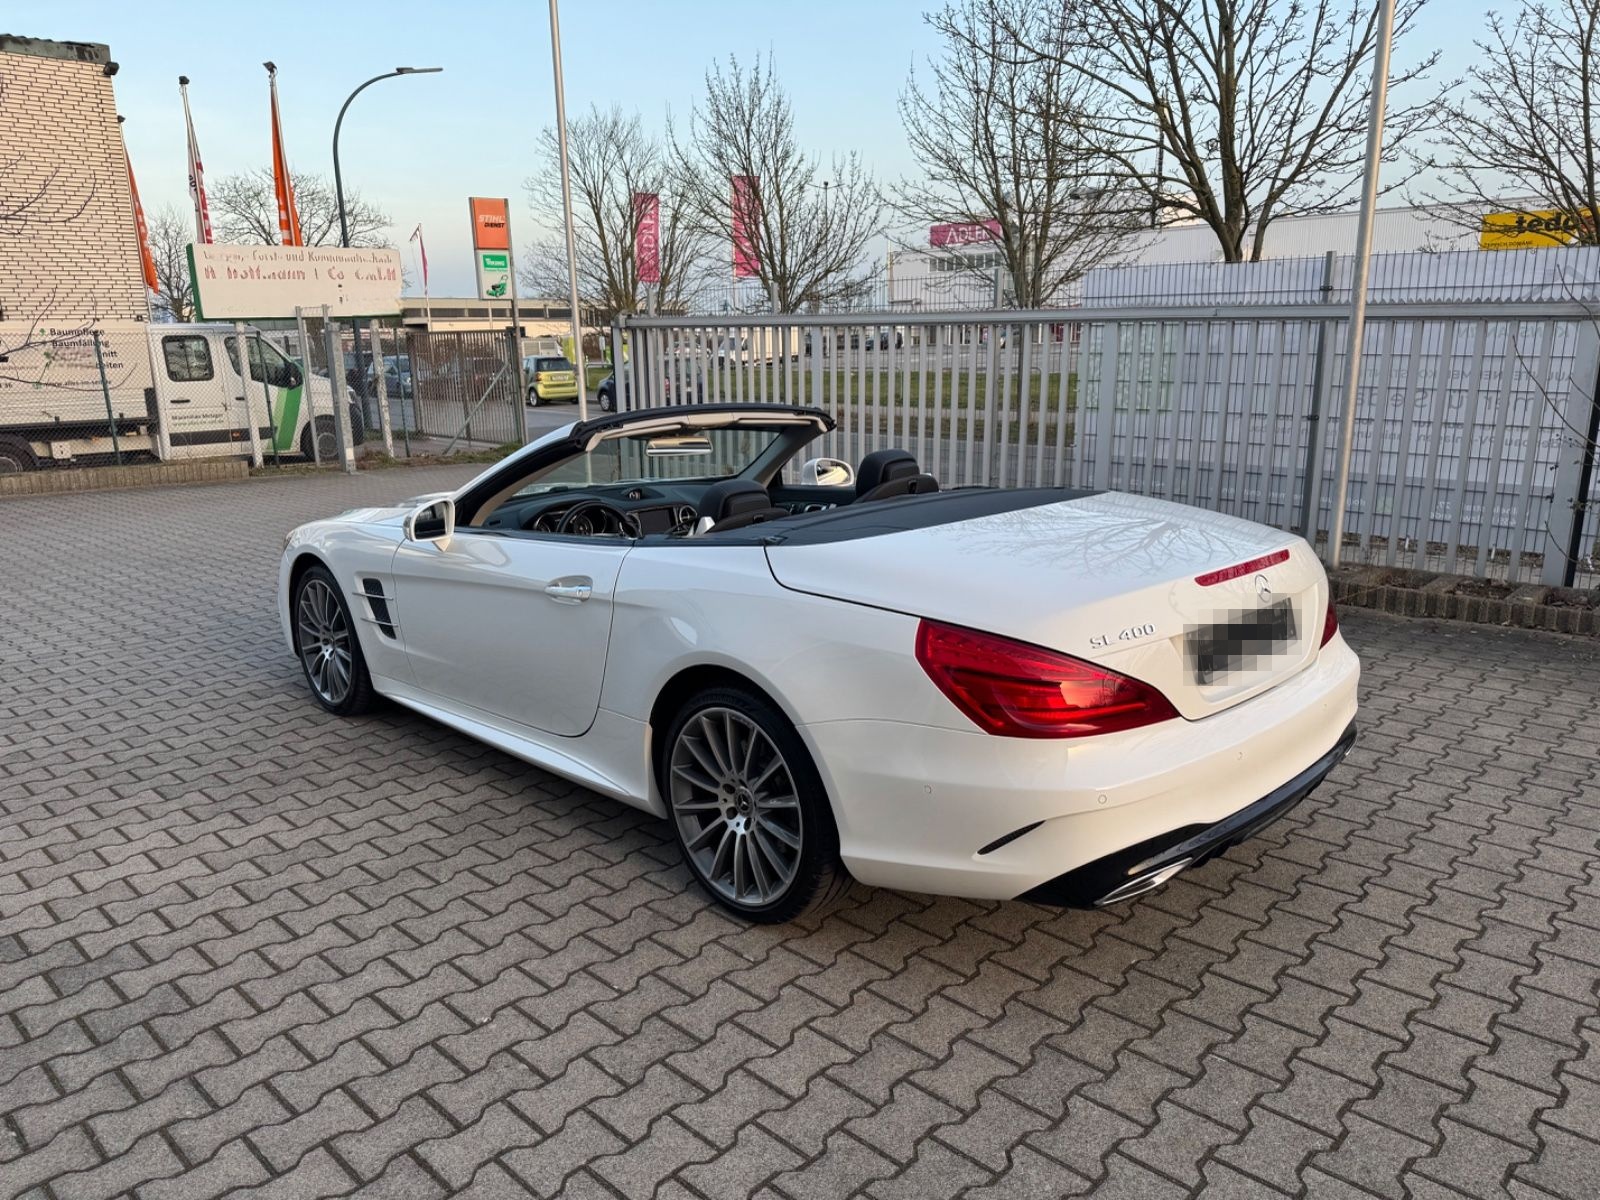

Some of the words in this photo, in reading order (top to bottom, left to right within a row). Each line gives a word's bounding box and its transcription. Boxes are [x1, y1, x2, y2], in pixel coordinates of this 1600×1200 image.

[946, 225, 991, 244] ADLER
[1090, 635, 1111, 650] SL
[1119, 623, 1155, 641] 400
